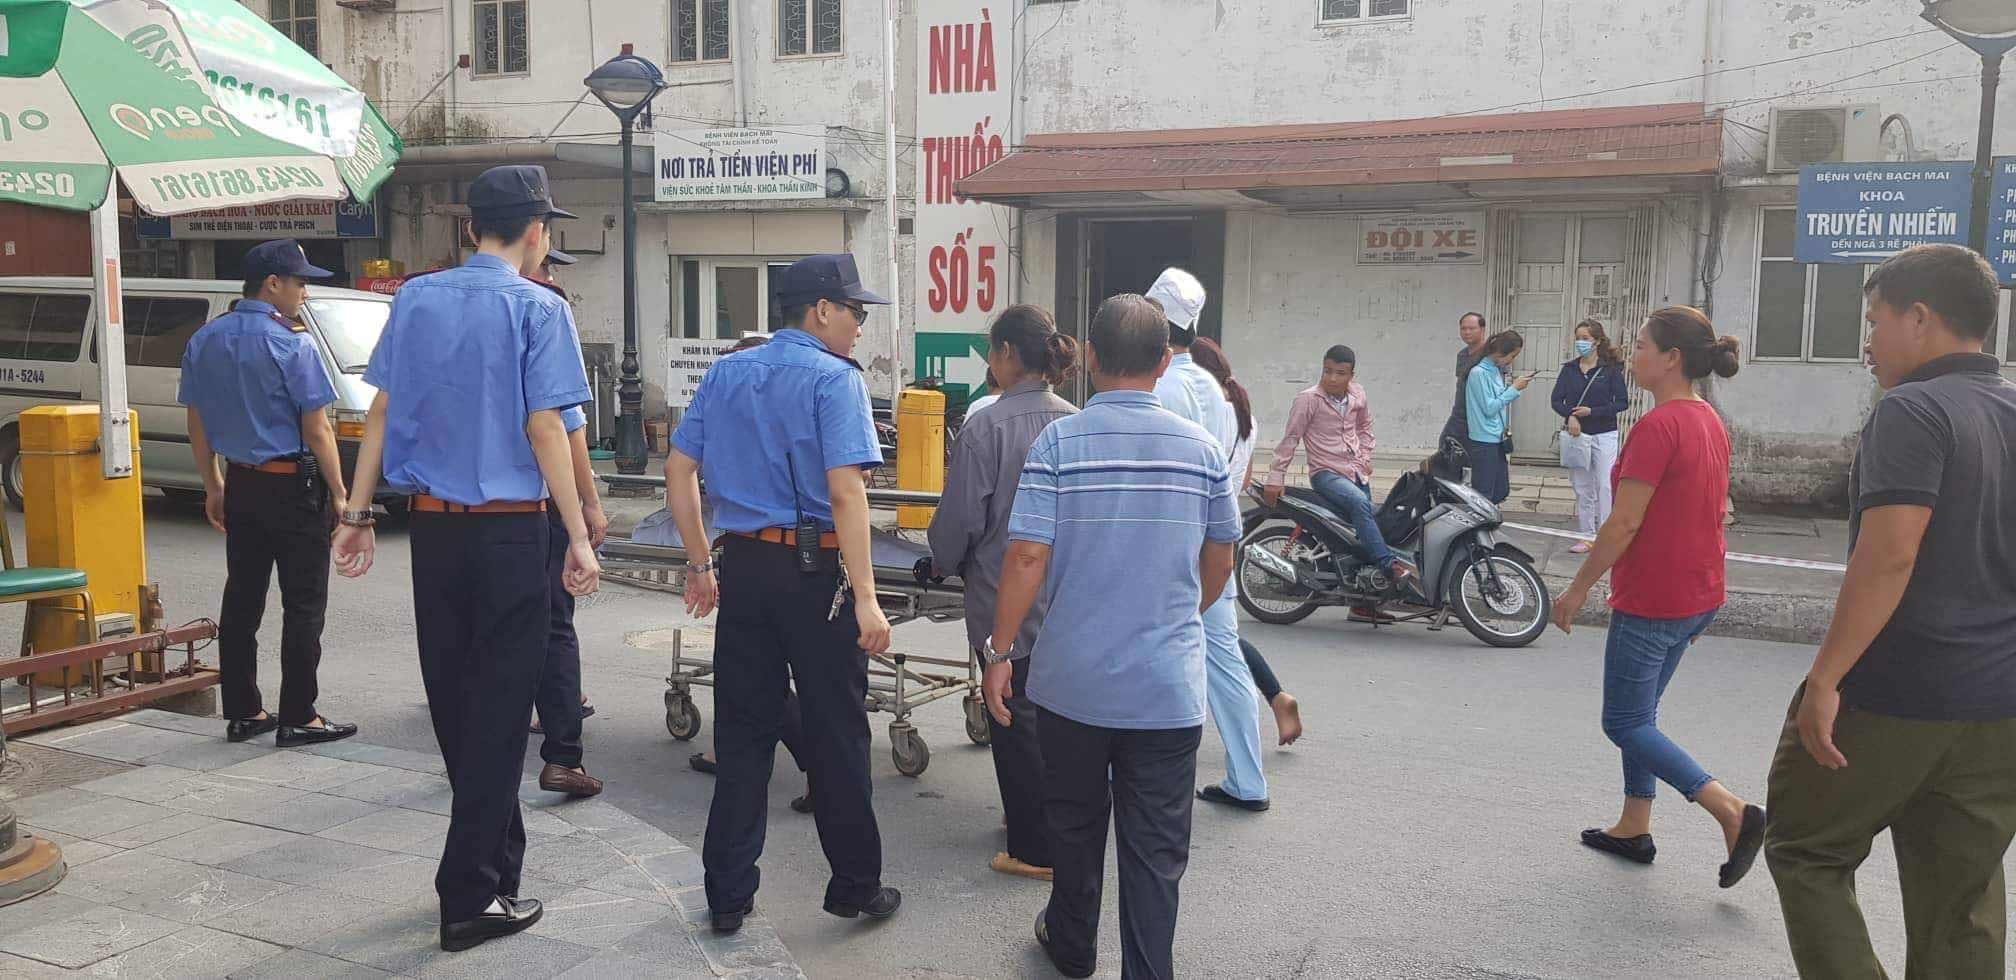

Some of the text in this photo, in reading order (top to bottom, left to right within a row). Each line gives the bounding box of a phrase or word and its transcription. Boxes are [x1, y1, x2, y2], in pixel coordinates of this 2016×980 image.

[928, 8, 997, 95] NHÀ
[661, 148, 817, 180] NƠI TRẢ TIỀN VIỆN PHÍ
[1816, 170, 1950, 183] BỆNH VIỆN BẠCH MAI
[717, 183, 732, 194] TÂM
[758, 183, 777, 193] KHOA
[800, 182, 818, 193] KINH
[1859, 191, 1905, 202] KHOA
[189, 221, 202, 231] SIM
[1807, 206, 1957, 236] TRUYỀN NHIỄM
[1365, 227, 1477, 251] ĐỘI XE
[1879, 240, 1885, 249] 3
[928, 227, 996, 314] SỐ 5
[687, 374, 703, 384] THEO
